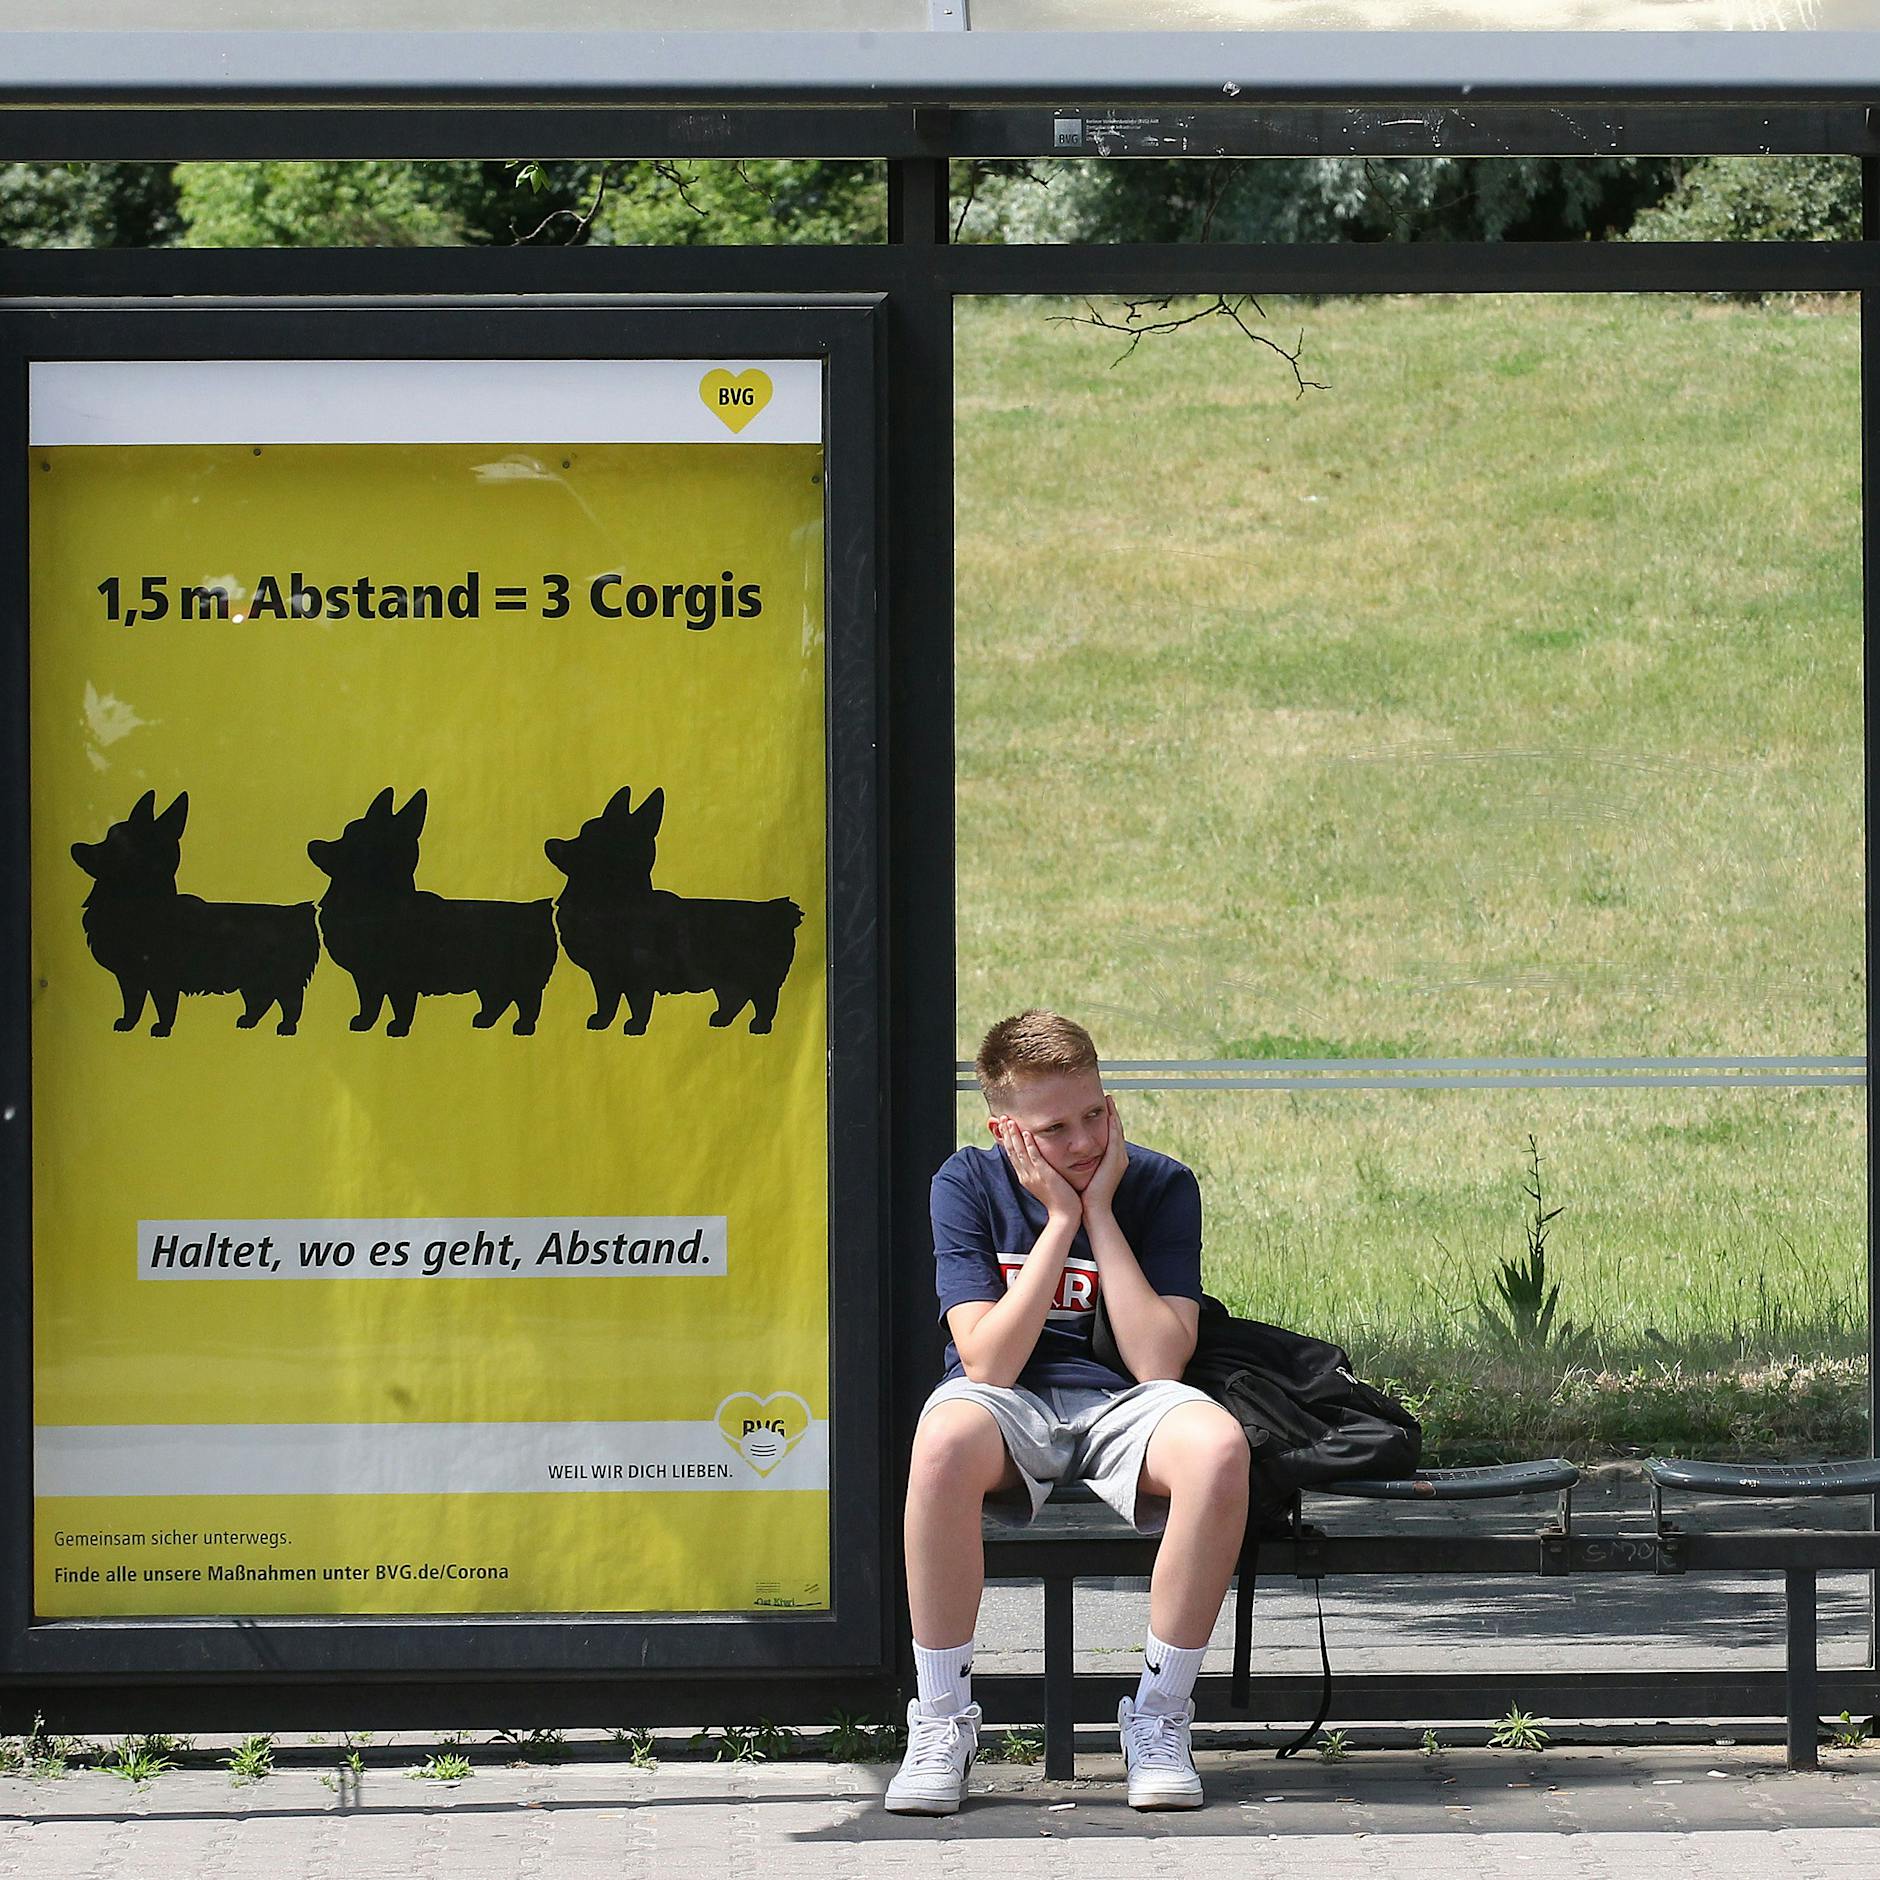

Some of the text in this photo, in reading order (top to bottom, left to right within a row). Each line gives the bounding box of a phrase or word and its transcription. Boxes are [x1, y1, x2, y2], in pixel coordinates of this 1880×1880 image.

[1059, 133, 1078, 144] BVG
[719, 387, 754, 406] BVG
[97, 570, 762, 631] 1,5 m Abstand = 3 Corgis
[150, 1228, 710, 1276] Haltet, wo es geht, Abstand.
[548, 1464, 733, 1479] WEIL WIR DICH LIEBEN.
[54, 1529, 292, 1549] Gemeinsam sicher unterwegs.
[55, 1563, 509, 1583] Finde alle unsere Maßnahmen unter BVG.de/Corona
